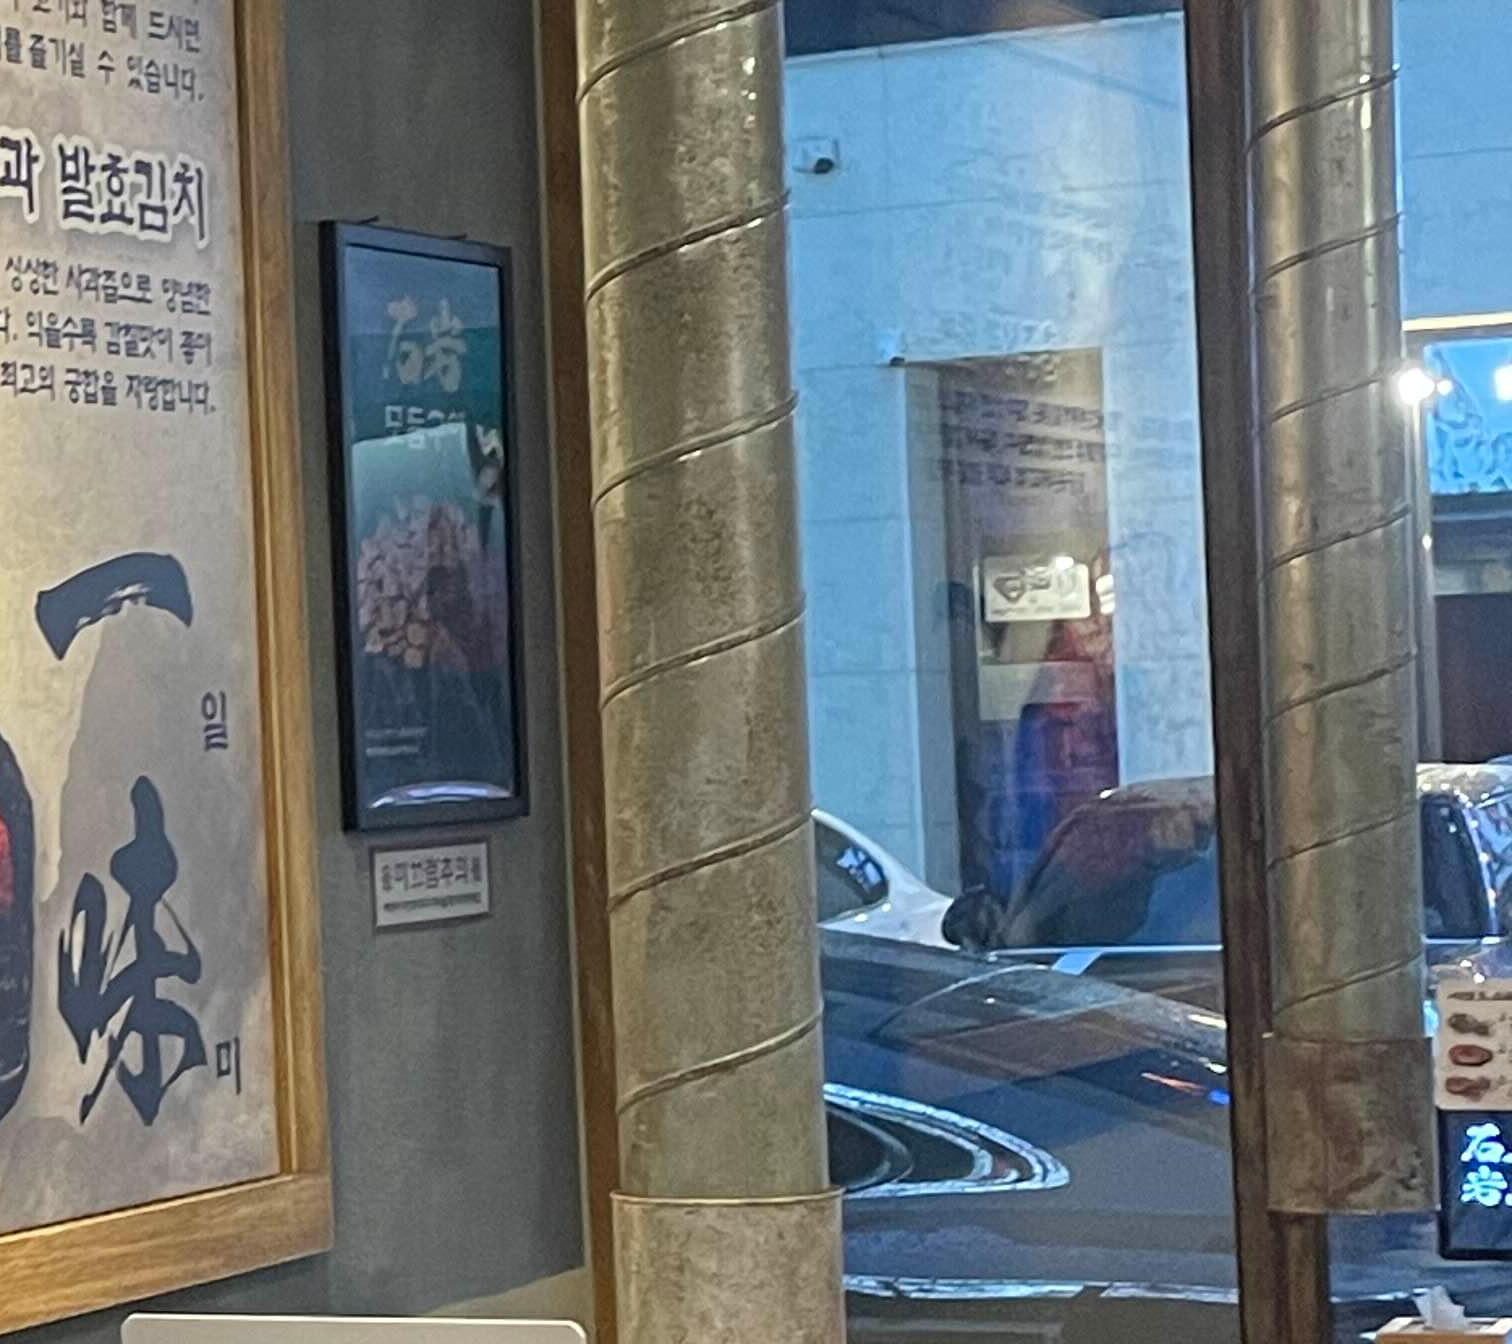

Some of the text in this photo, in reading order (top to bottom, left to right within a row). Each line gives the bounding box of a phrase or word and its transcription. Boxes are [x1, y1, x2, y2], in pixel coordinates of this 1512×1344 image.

[97, 49, 116, 85] 수
[57, 143, 207, 240] 발효김치
[202, 690, 229, 751] 일
[216, 1037, 241, 1094] 미
